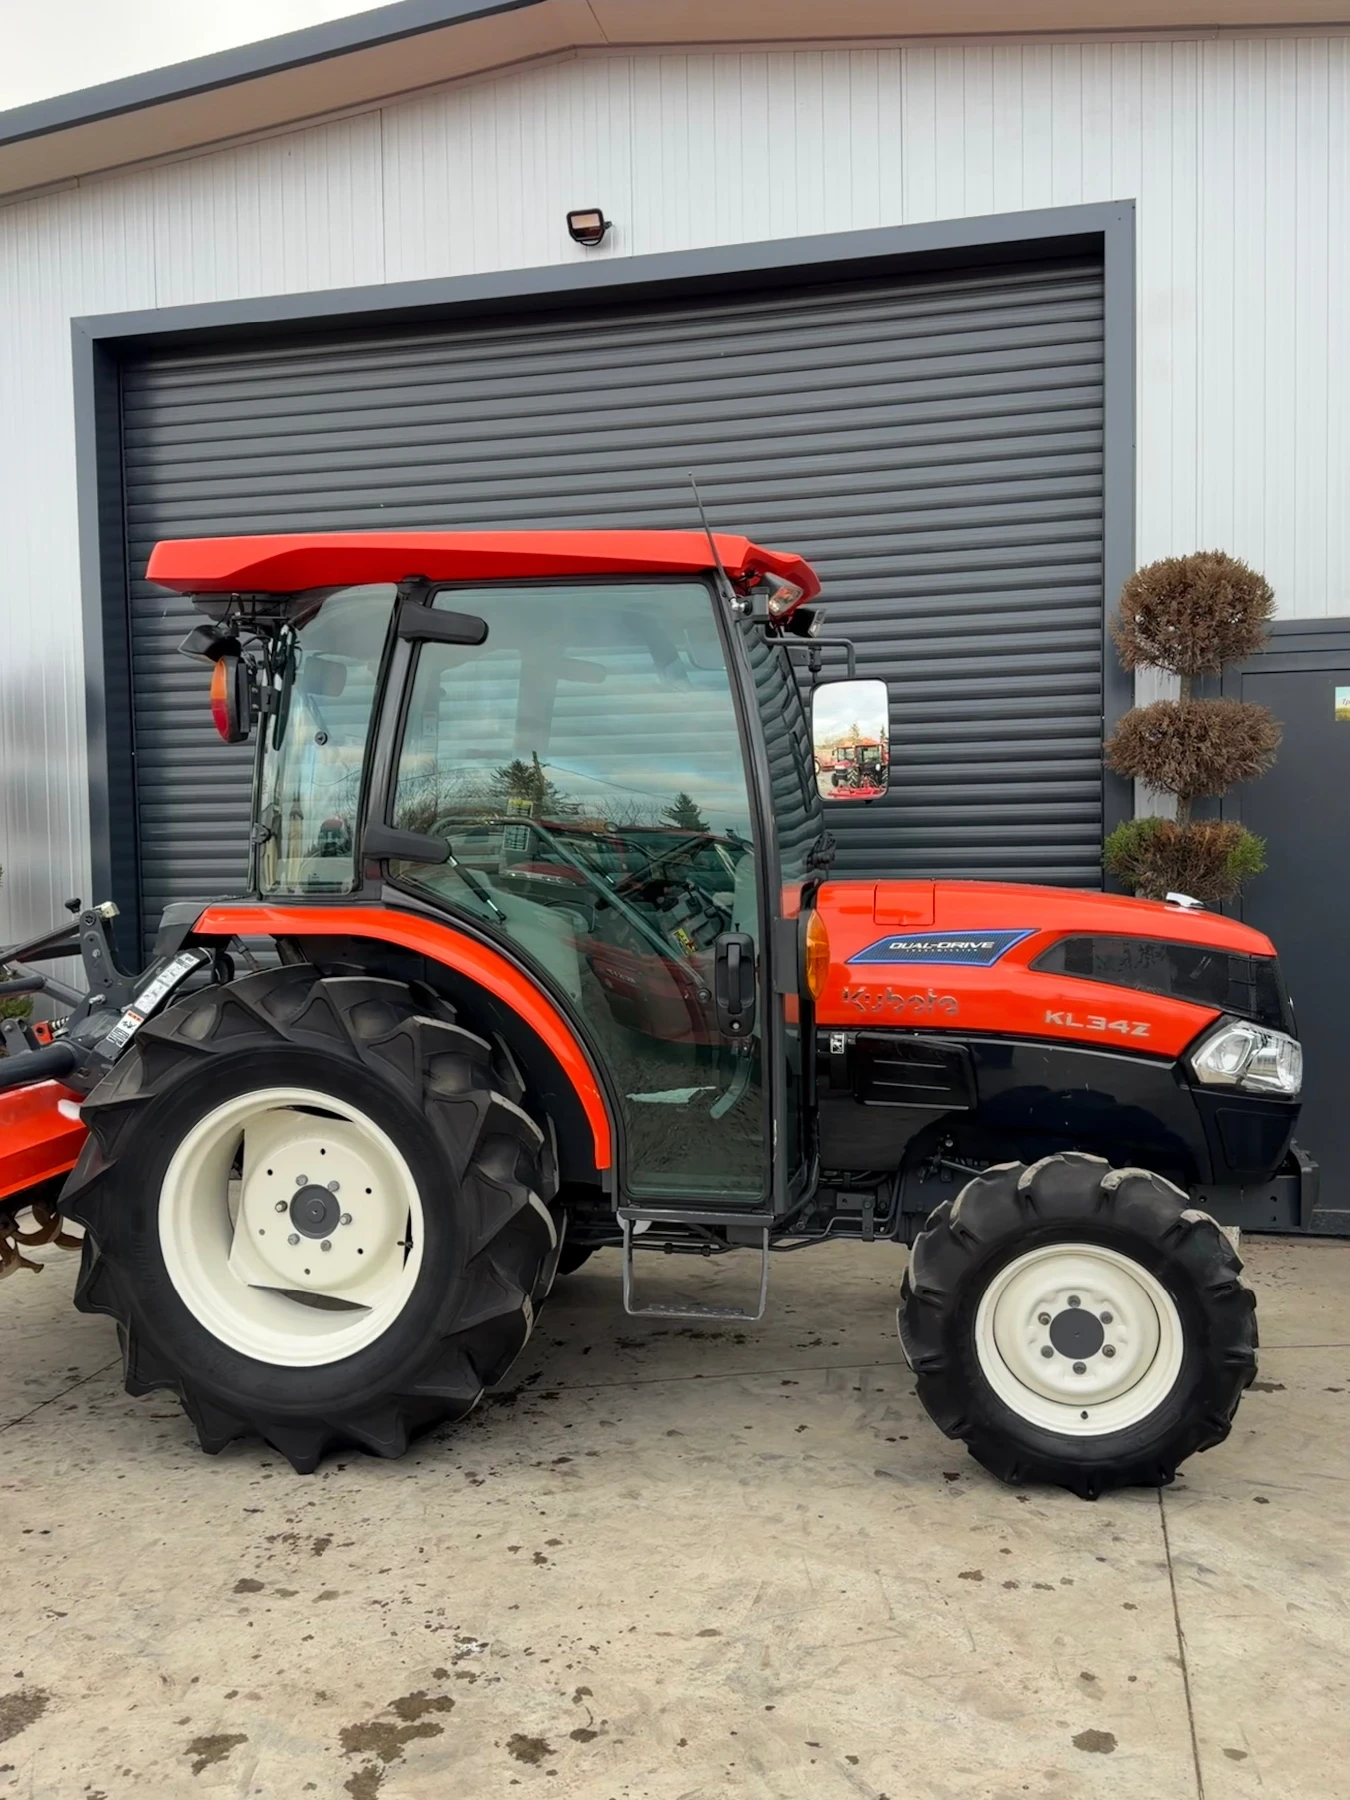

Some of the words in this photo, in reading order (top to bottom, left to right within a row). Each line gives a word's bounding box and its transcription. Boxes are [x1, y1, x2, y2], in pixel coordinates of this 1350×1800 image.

[889, 941, 995, 949] DUAL-DRIVE
[843, 987, 958, 1014] Kubota
[1045, 1010, 1151, 1037] KL34Z
